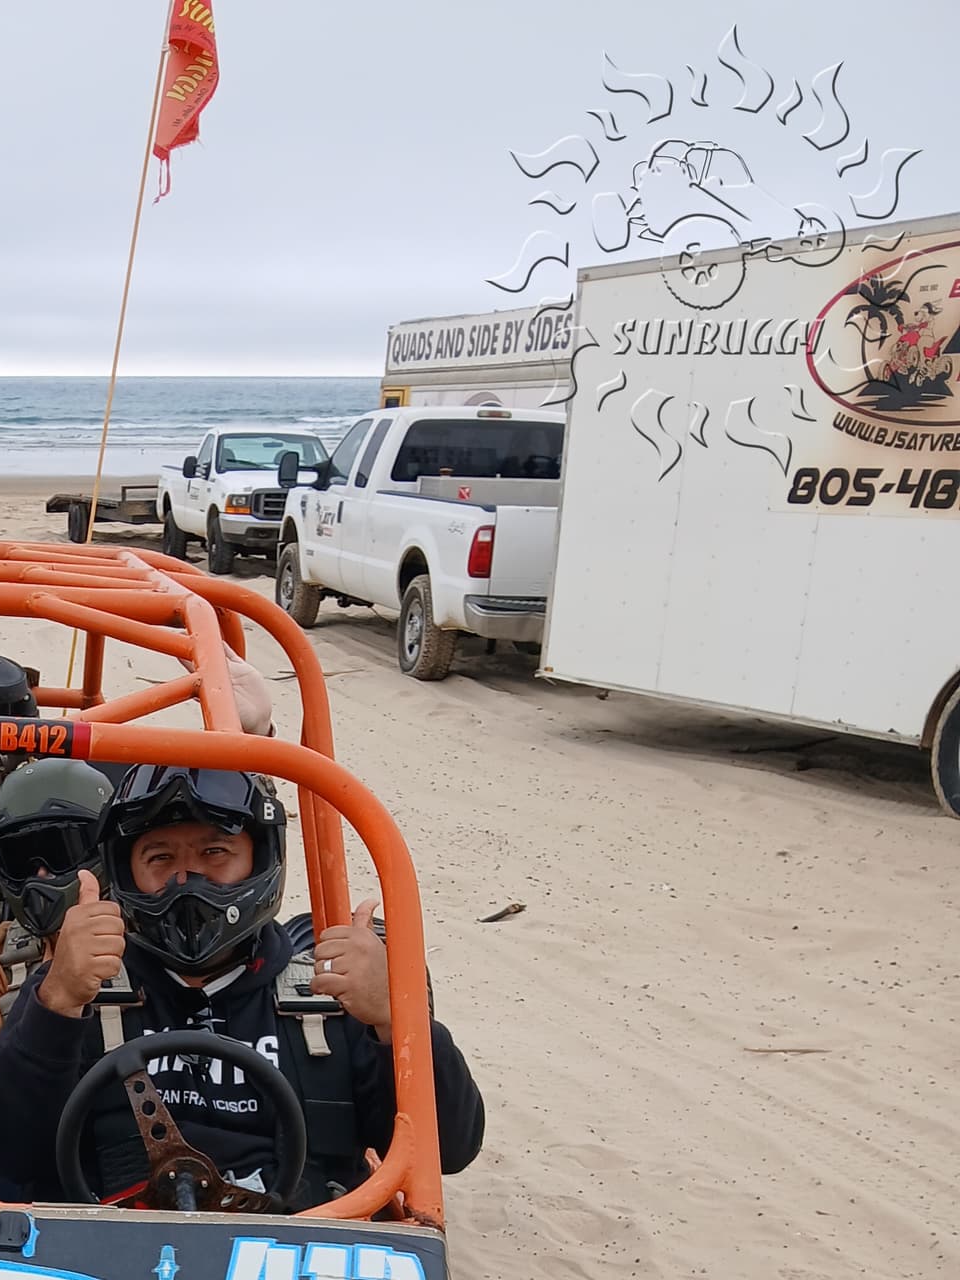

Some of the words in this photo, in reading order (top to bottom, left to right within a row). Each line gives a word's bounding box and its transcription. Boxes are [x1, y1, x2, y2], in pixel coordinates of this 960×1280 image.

[392, 331, 433, 364] QUADS
[434, 327, 465, 359] AND
[467, 323, 500, 357] SIDE
[502, 319, 524, 354] BY
[525, 313, 573, 353] SIDES
